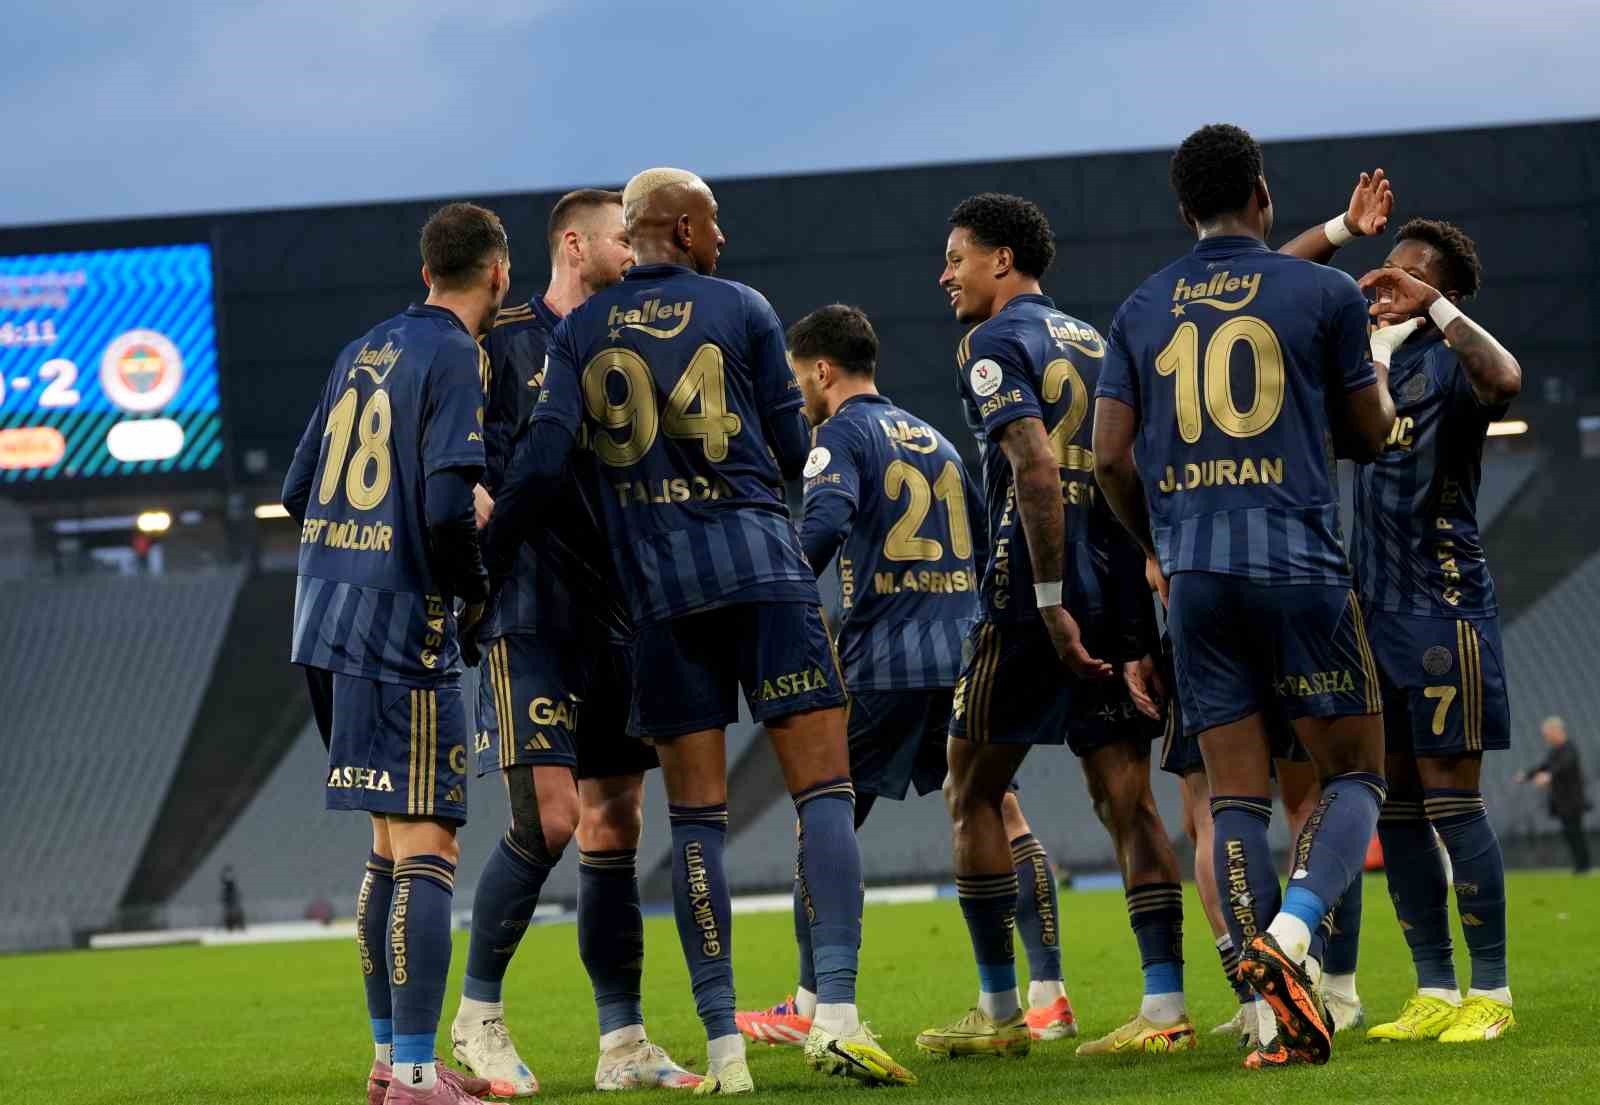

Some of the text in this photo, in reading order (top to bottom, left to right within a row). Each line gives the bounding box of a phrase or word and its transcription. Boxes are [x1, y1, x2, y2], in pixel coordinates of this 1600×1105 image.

[1172, 271, 1262, 311] halley
[607, 298, 693, 339] halley
[354, 342, 402, 384] halley
[1154, 315, 1286, 444] 10
[582, 344, 741, 467] 94
[318, 387, 392, 511] 18
[1159, 458, 1283, 492] J.DURAN
[883, 459, 971, 561] 21
[1423, 686, 1457, 735] 7
